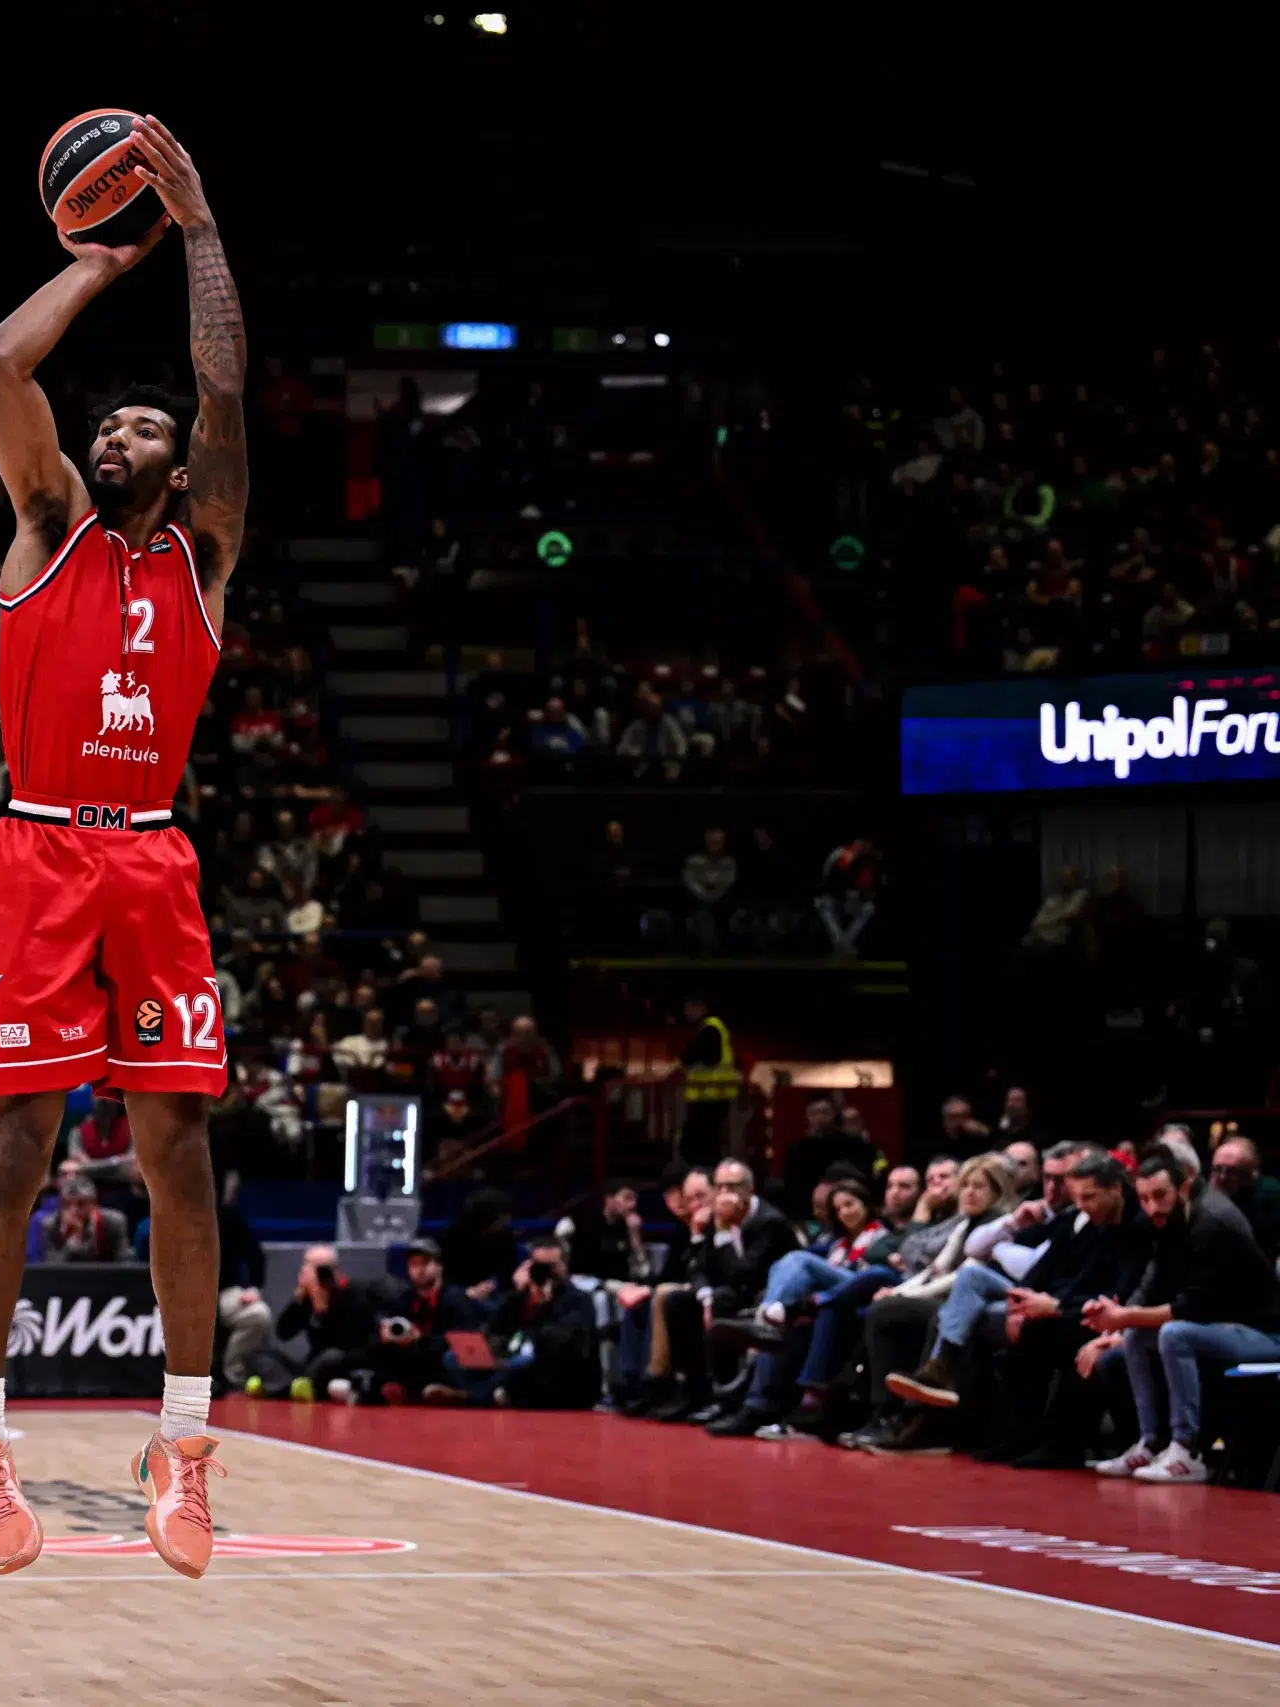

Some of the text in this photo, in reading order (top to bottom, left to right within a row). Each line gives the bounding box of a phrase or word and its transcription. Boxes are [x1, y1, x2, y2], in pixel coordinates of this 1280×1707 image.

[82, 740, 159, 764] plenitude
[76, 804, 127, 830] OM
[0, 1026, 26, 1038] EA7
[59, 1026, 84, 1039] EA7
[172, 993, 217, 1049] 12
